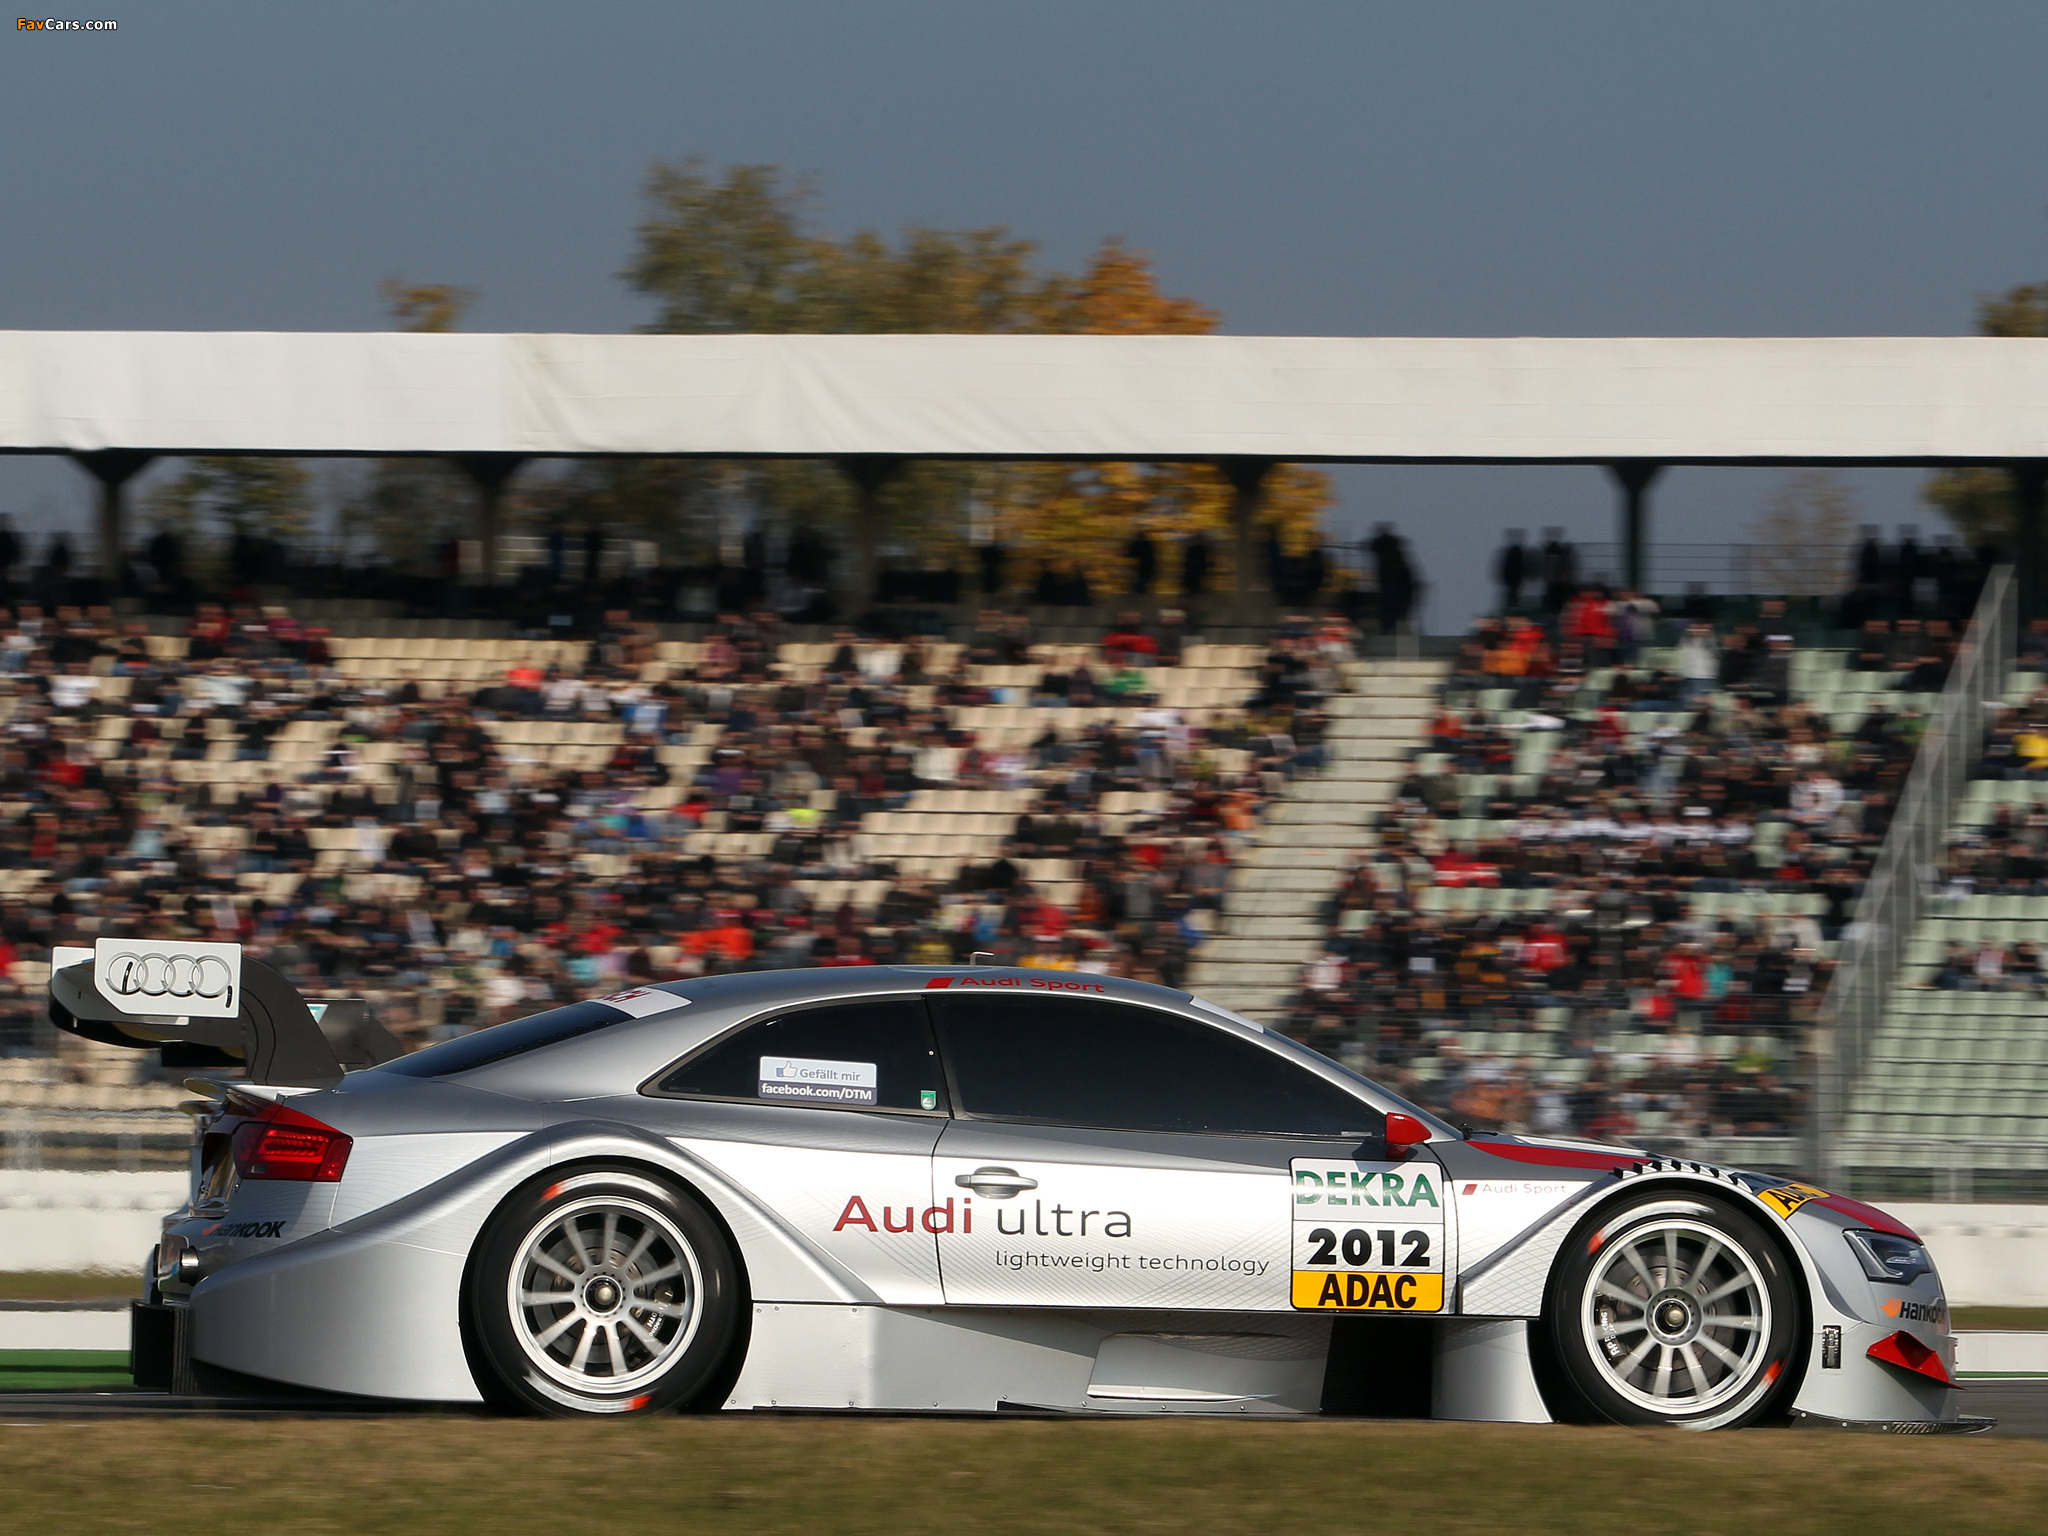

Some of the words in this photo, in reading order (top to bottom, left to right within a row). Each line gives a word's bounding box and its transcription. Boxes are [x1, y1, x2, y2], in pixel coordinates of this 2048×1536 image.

[960, 977, 1021, 987] Audi
[1030, 978, 1106, 993] Sport
[800, 1068, 838, 1081] Gefällt
[841, 1072, 861, 1082] mir
[762, 1083, 873, 1101] facebook.com/DTM
[1295, 1170, 1440, 1208] DEKRA
[1482, 1183, 1518, 1193] Audi
[1523, 1183, 1567, 1195] Sport
[832, 1195, 972, 1234] Audi
[997, 1199, 1132, 1238] ultra
[1306, 1228, 1430, 1267] 2012
[996, 1250, 1131, 1272] lightweight
[1138, 1254, 1270, 1276] technology
[1317, 1273, 1418, 1309] ADAC
